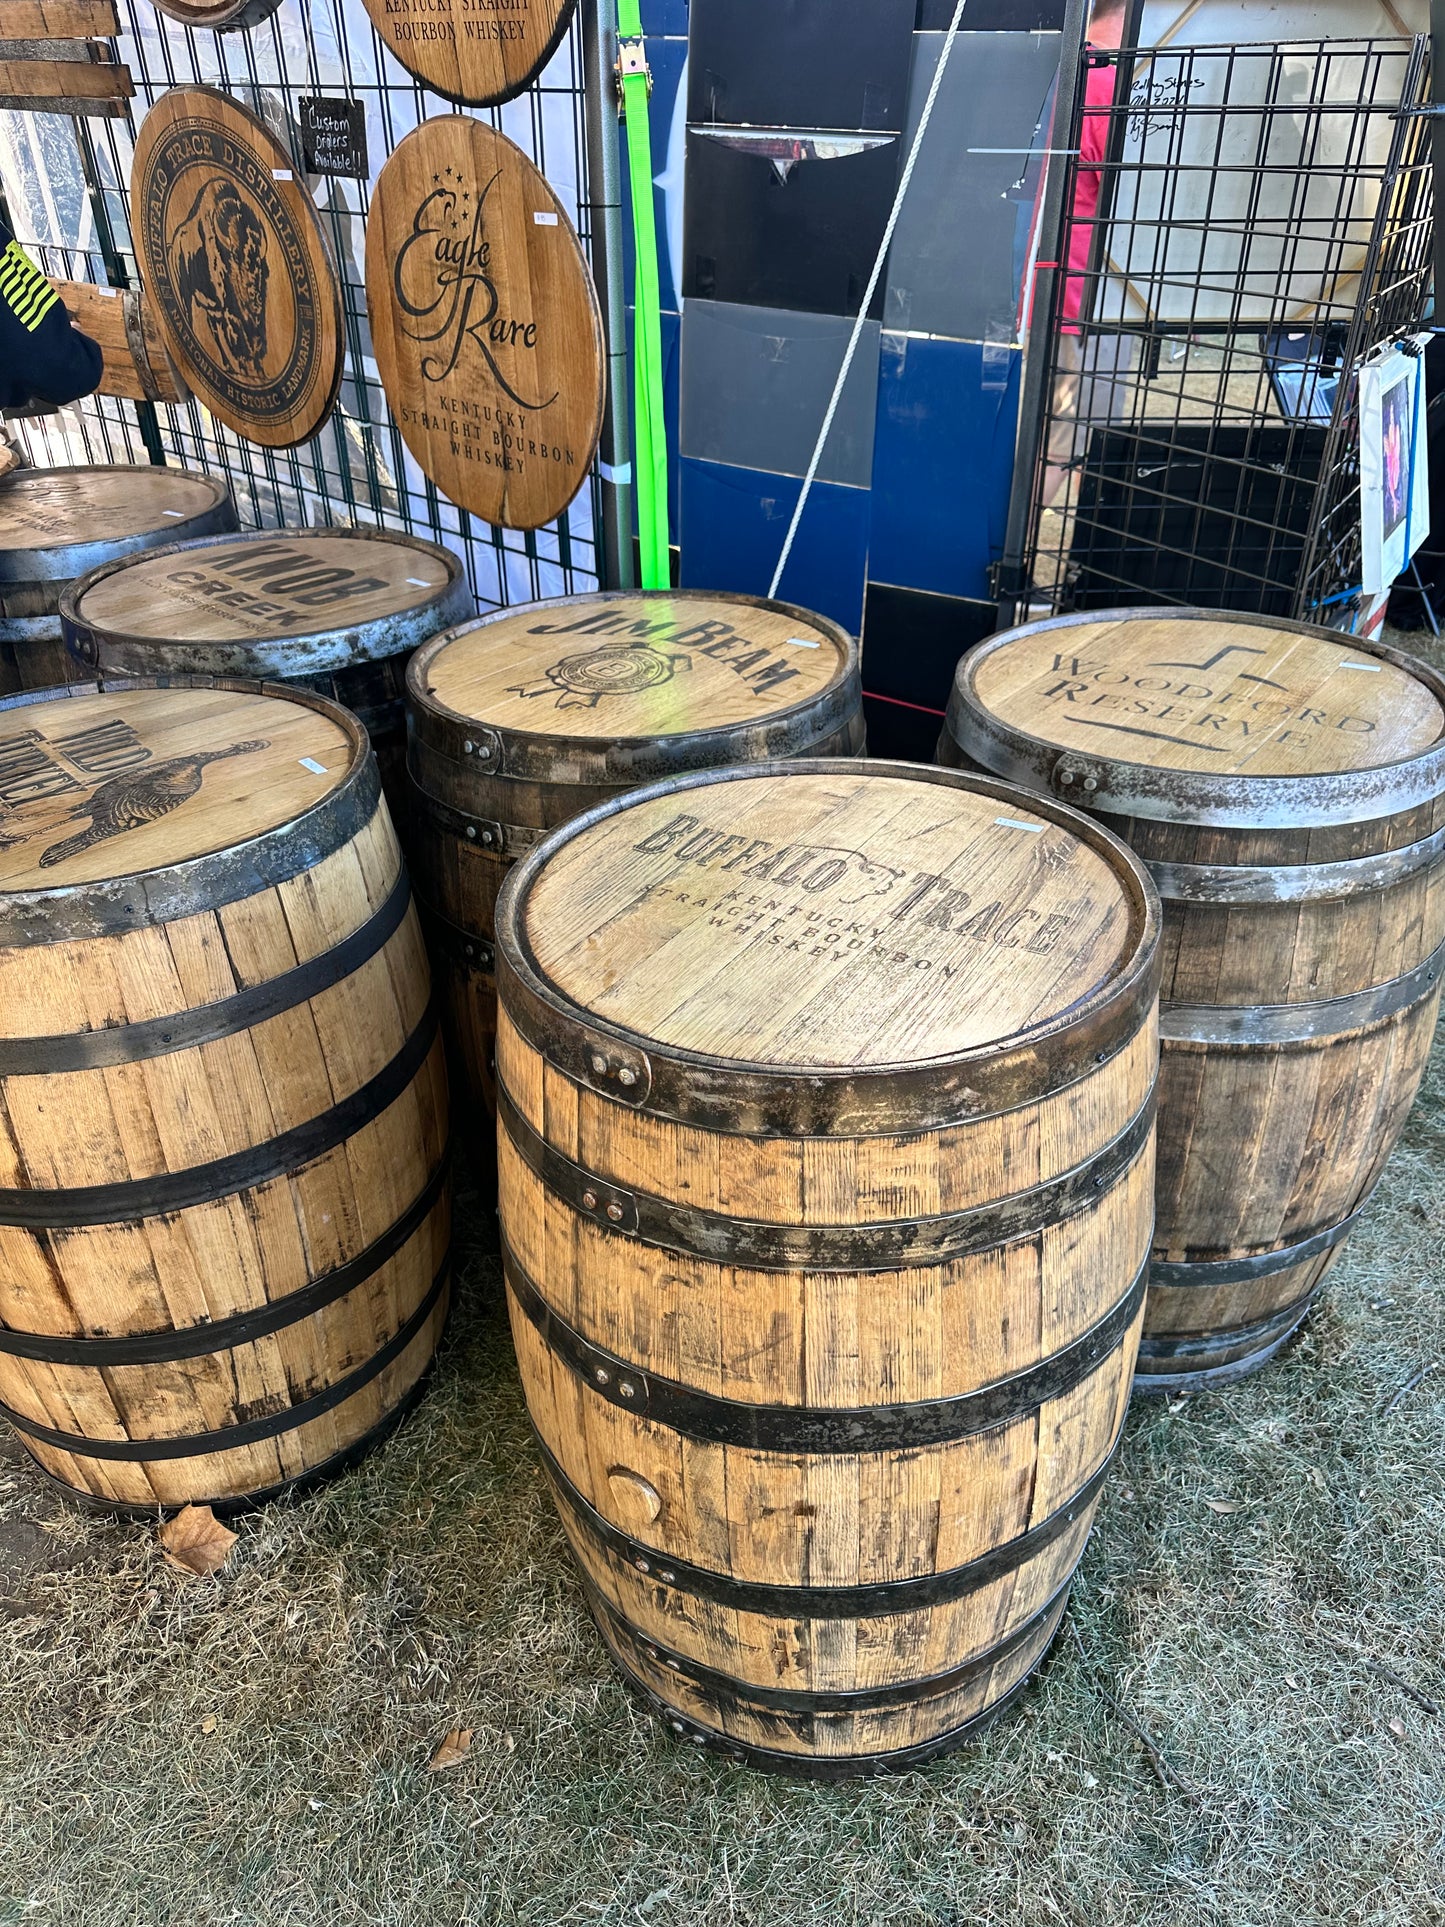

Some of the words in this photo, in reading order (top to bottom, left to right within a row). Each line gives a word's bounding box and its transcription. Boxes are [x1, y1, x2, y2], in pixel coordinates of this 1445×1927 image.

[394, 21, 456, 41] BOURBON
[464, 21, 526, 40] WHISKEY
[308, 104, 350, 131] Custom
[315, 150, 360, 175] Available!!
[151, 168, 168, 279] BUFFALO
[166, 135, 214, 169] TRACE
[223, 143, 310, 299] DISTILLERY
[394, 171, 501, 339] Eagle
[171, 309, 222, 388] NATIONAL
[227, 384, 281, 410] HISTORIC
[281, 328, 311, 400] LANDMARK
[421, 269, 559, 409] Rare
[402, 408, 481, 440] STRAIGHT
[493, 431, 575, 466] BOURBON
[440, 396, 526, 430] KENTUCKY
[450, 441, 524, 474] WHISKEY
[166, 571, 309, 627] CREEK
[200, 544, 390, 606] KNOB
[527, 610, 677, 638] JIM
[661, 620, 802, 696] BEAM
[1035, 678, 1313, 749] RESERVE
[1052, 654, 1377, 733] WOODFORD
[46, 719, 153, 773] WILD
[633, 814, 849, 894] BUFFALO
[889, 872, 1073, 956] TRACE
[726, 890, 886, 940] KENTUCKY
[640, 884, 786, 928] STRAIGHT
[802, 926, 958, 978] BOURBON
[709, 916, 849, 962] WHISKEY
